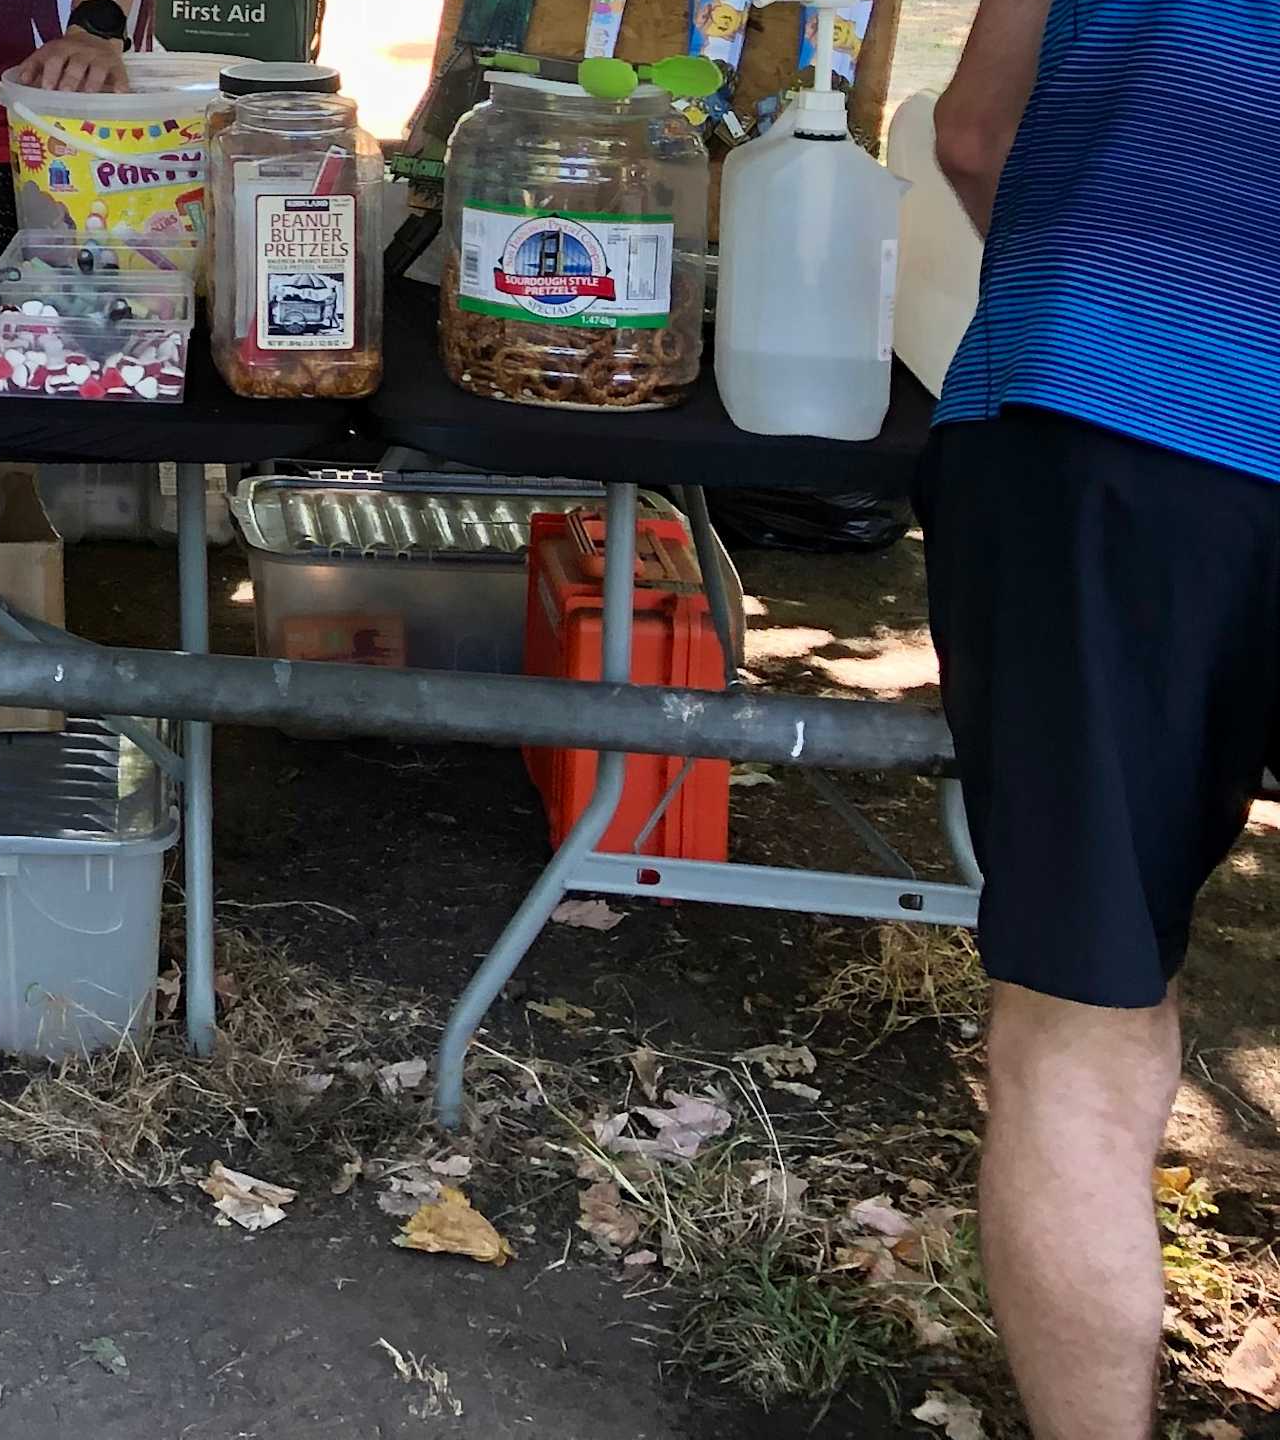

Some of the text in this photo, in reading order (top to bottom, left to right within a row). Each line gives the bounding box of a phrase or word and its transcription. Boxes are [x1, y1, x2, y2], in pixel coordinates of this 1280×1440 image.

[171, 0, 266, 23] First Aid
[270, 213, 343, 228] PEANUT
[271, 228, 343, 243] BUTTER
[264, 242, 349, 257] PRETZELS
[504, 274, 599, 287] SOURDOUGH STYLE
[524, 284, 578, 296] PRETZELS
